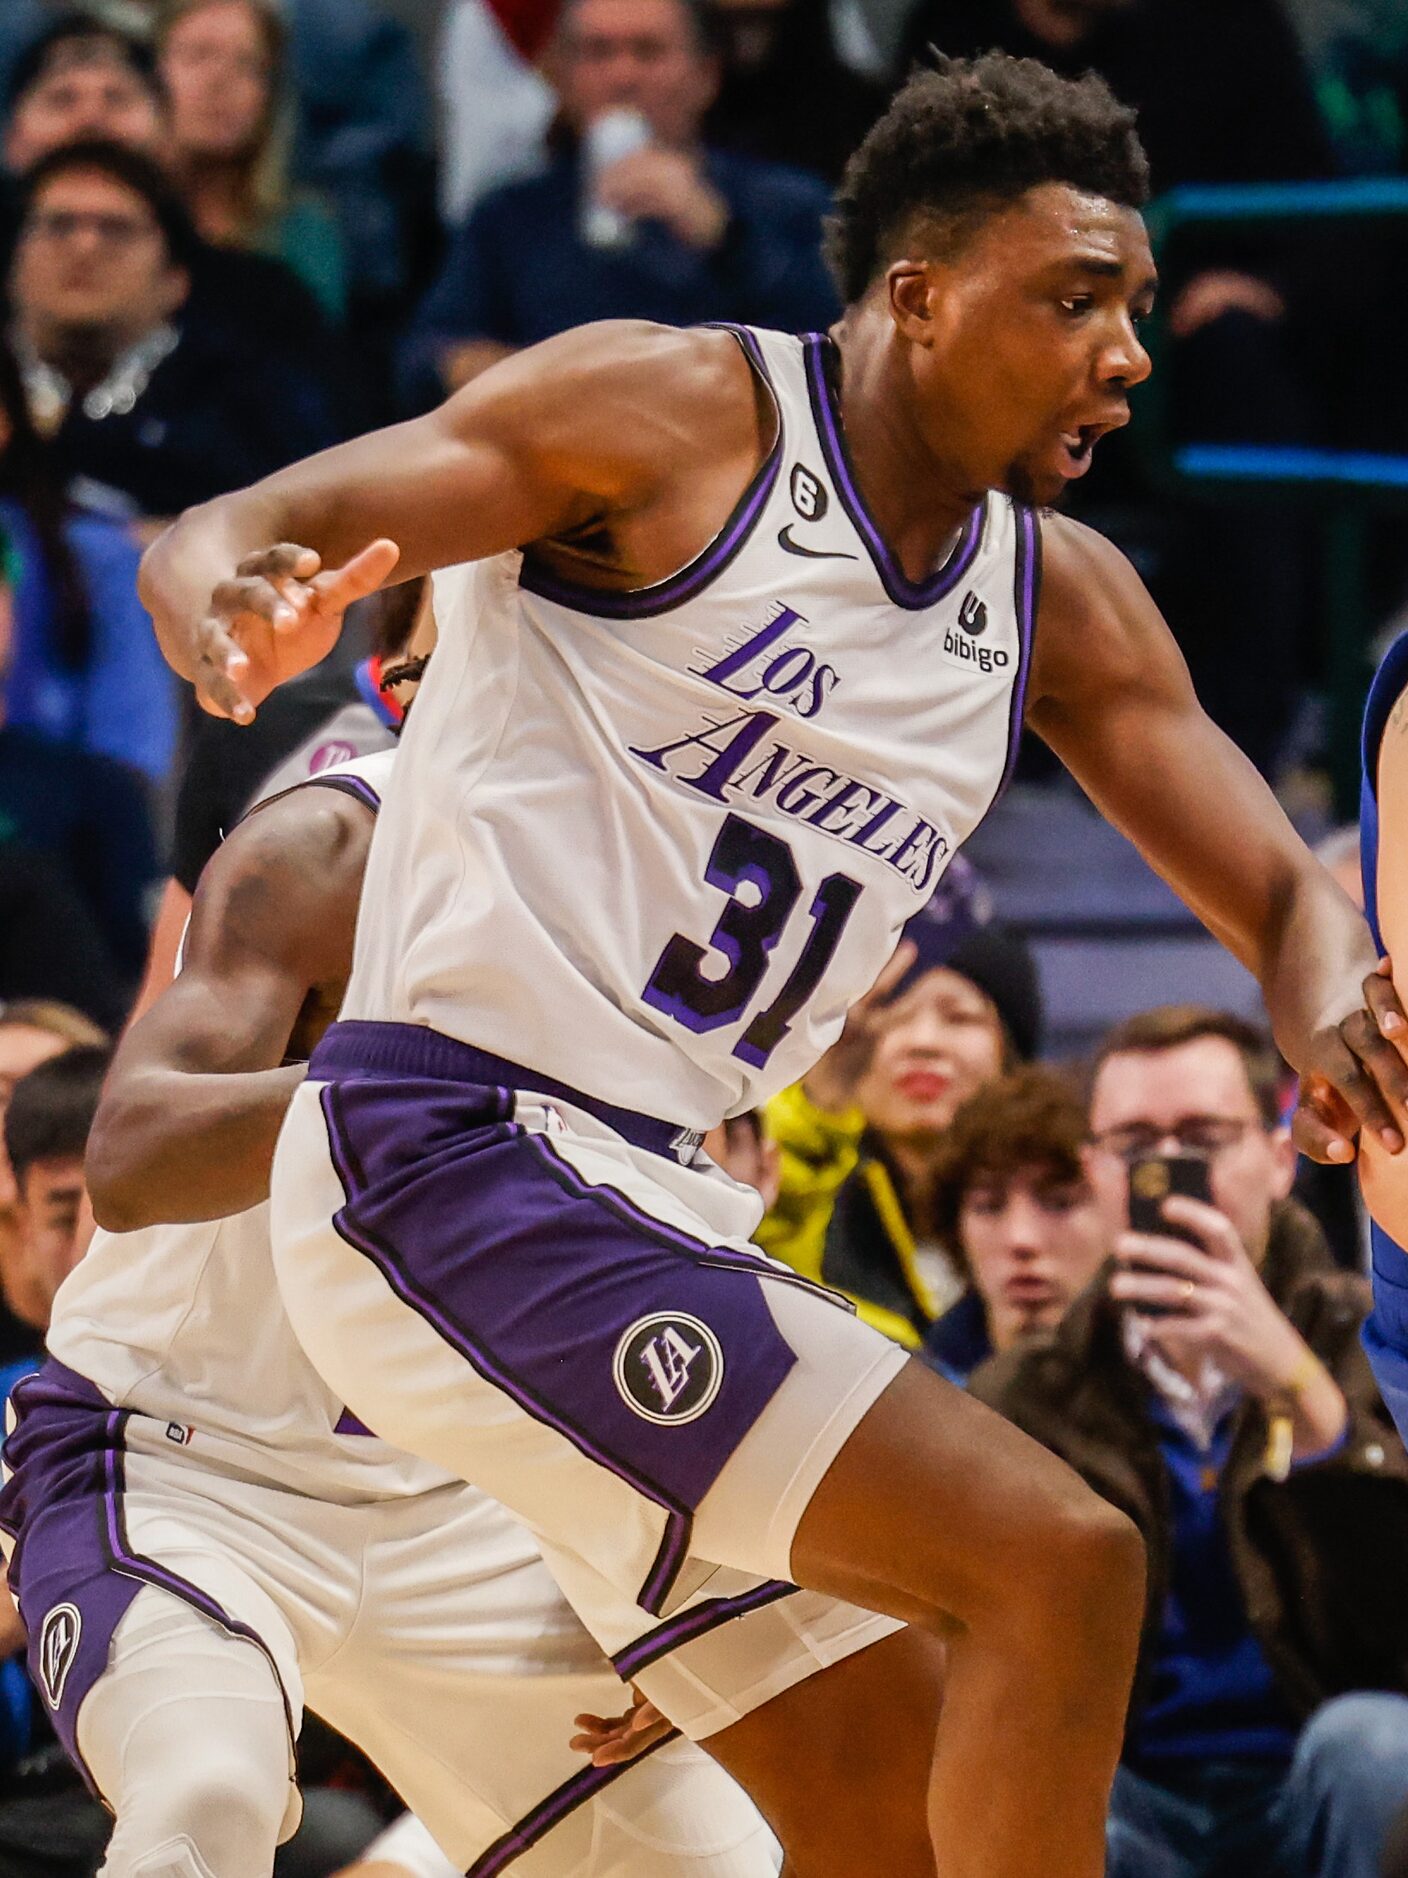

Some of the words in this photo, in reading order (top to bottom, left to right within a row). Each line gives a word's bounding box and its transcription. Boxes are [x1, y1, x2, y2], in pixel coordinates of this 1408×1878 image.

[795, 470, 818, 515] 6
[943, 627, 1009, 673] bibigo
[628, 706, 949, 891] ANGELES
[641, 813, 864, 1071] 31
